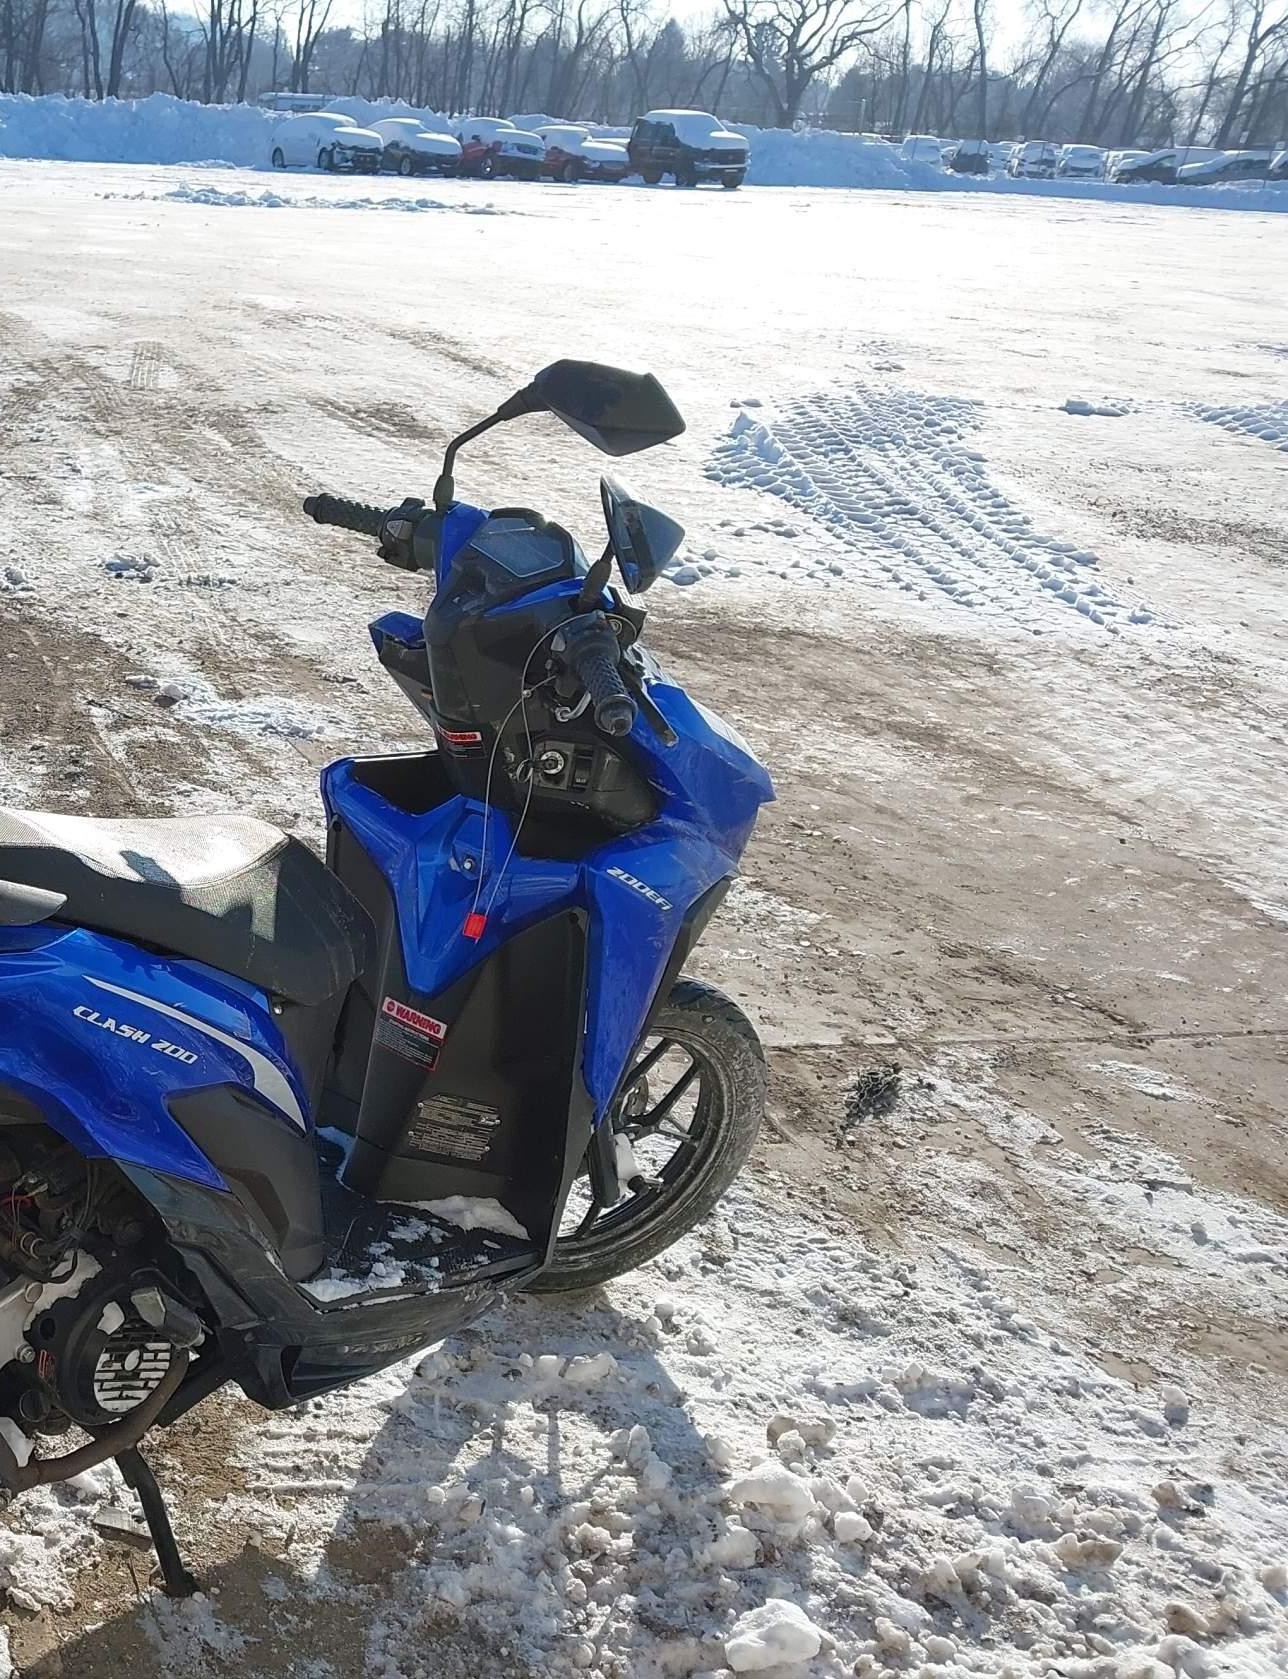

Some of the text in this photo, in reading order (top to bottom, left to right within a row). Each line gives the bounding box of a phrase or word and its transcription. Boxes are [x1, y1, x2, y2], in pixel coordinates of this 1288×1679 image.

[73, 1005, 198, 1064] CLASH 200
[395, 1005, 442, 1035] WARNING
